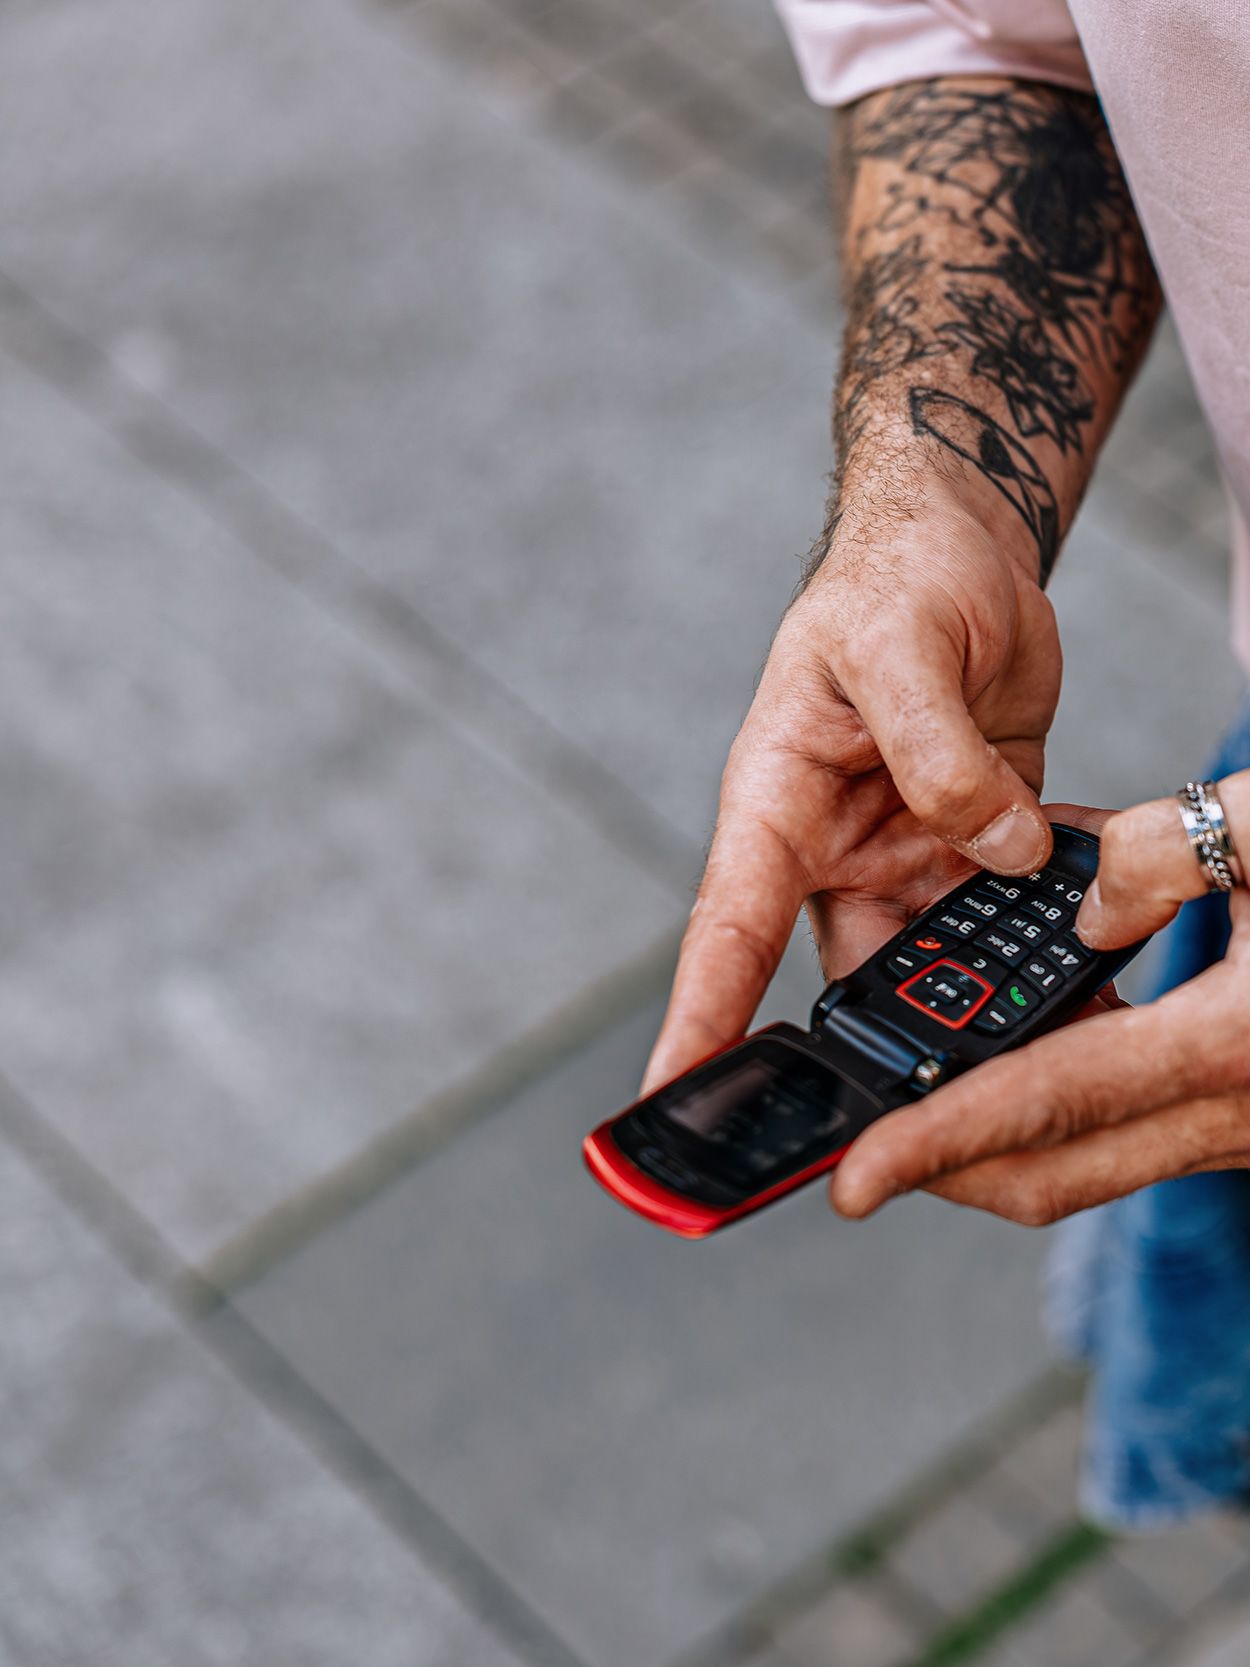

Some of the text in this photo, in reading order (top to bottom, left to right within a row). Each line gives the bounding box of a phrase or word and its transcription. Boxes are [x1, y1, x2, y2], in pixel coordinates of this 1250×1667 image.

[986, 880, 1020, 899] 9 wxyz
[981, 904, 997, 916] 6
[1031, 900, 1062, 920] 8 tuv
[958, 921, 976, 934] 3
[1023, 925, 1041, 939] 5
[1001, 942, 1020, 957] 2
[1061, 953, 1080, 965] 4
[1042, 974, 1056, 987] 1
